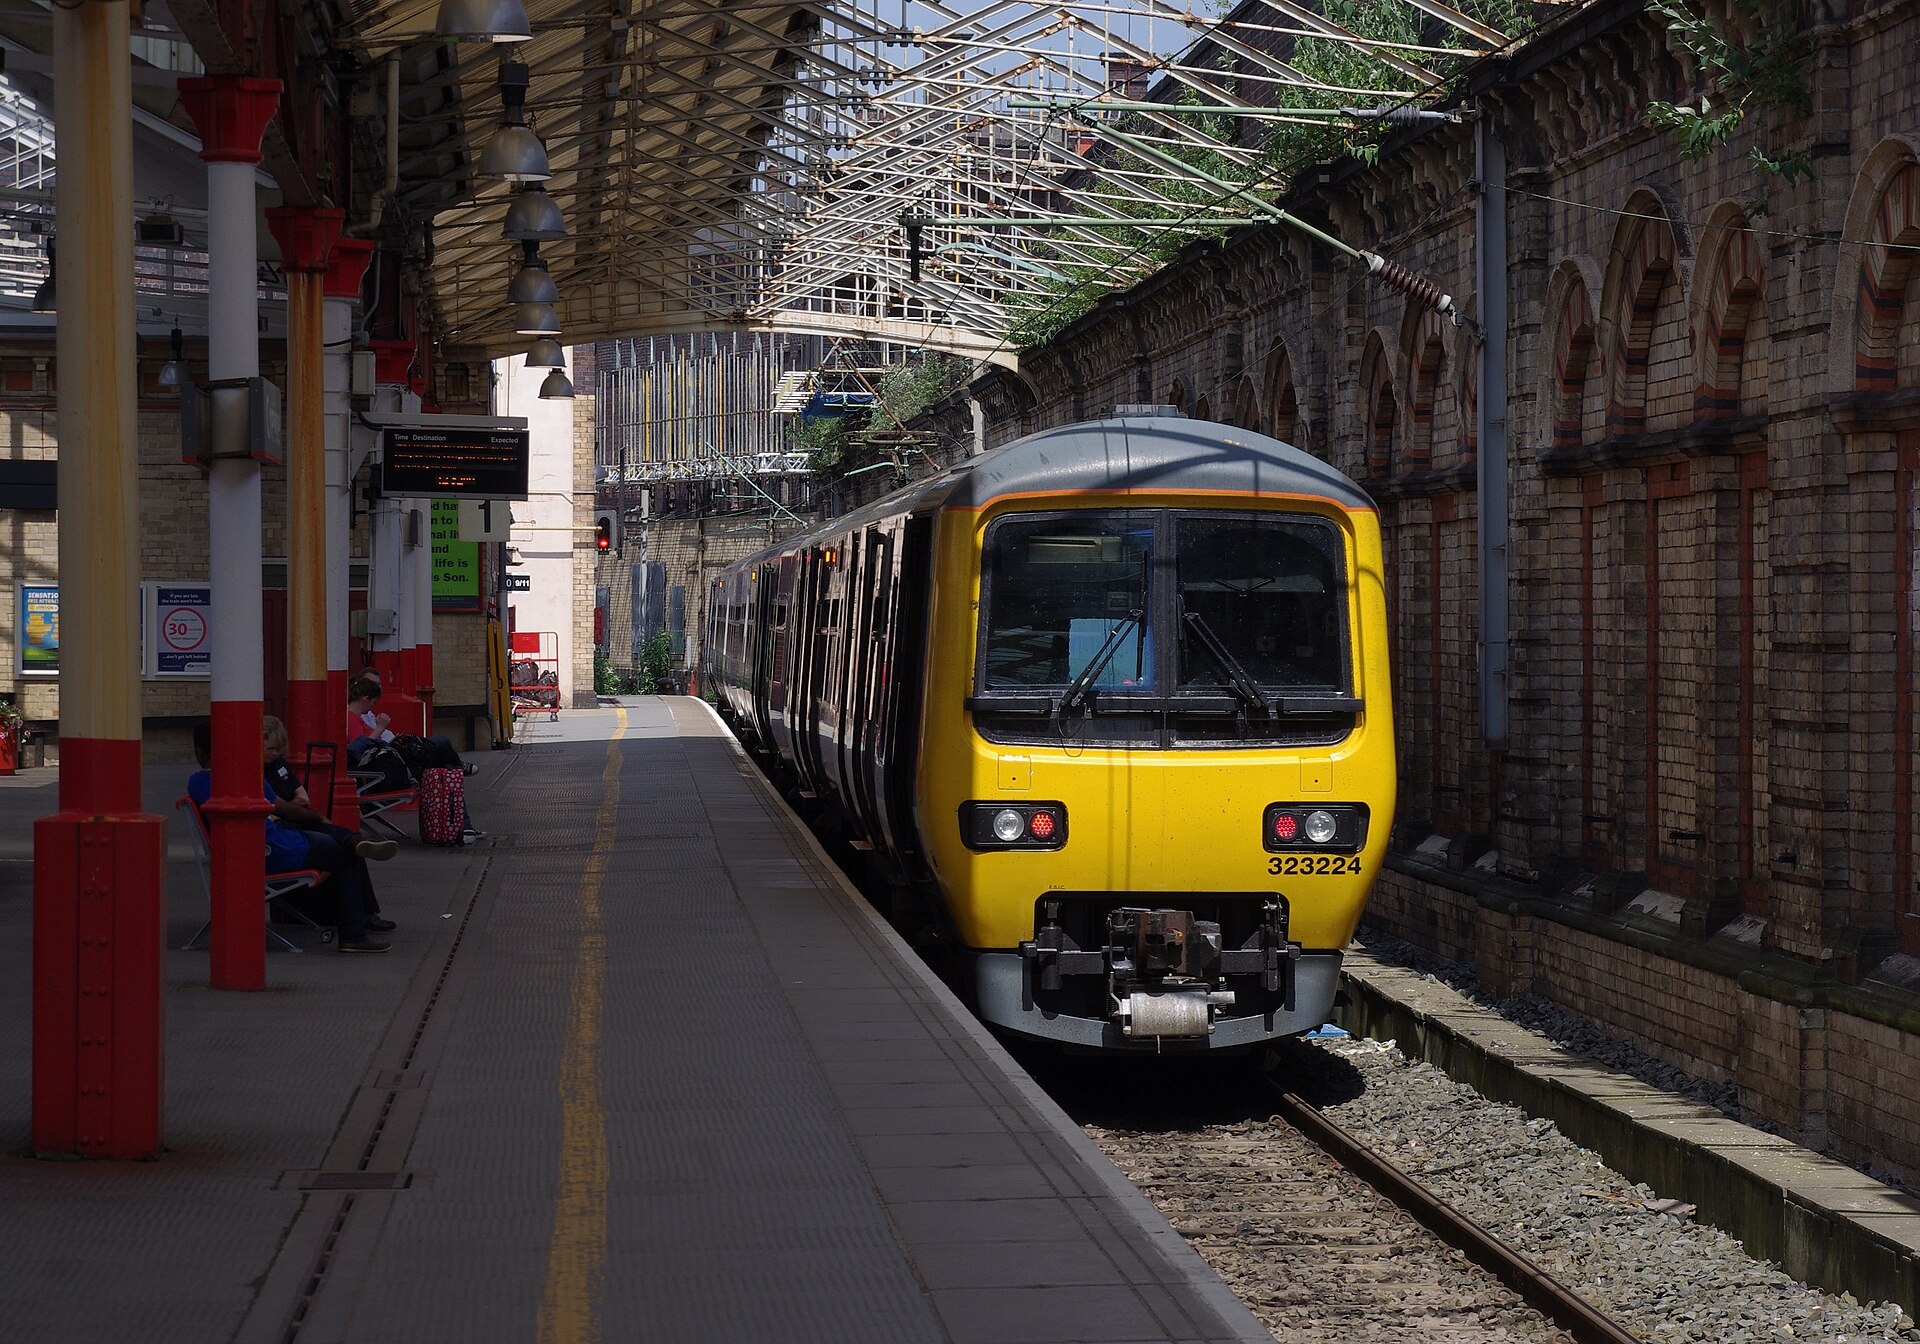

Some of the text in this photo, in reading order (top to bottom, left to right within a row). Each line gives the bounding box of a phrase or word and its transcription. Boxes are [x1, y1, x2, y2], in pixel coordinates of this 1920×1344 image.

[441, 516, 453, 524] to
[478, 500, 491, 533] 1
[435, 558, 468, 568] life is
[444, 572, 469, 582] Son.
[169, 623, 188, 635] 30
[1268, 857, 1362, 875] 323224
